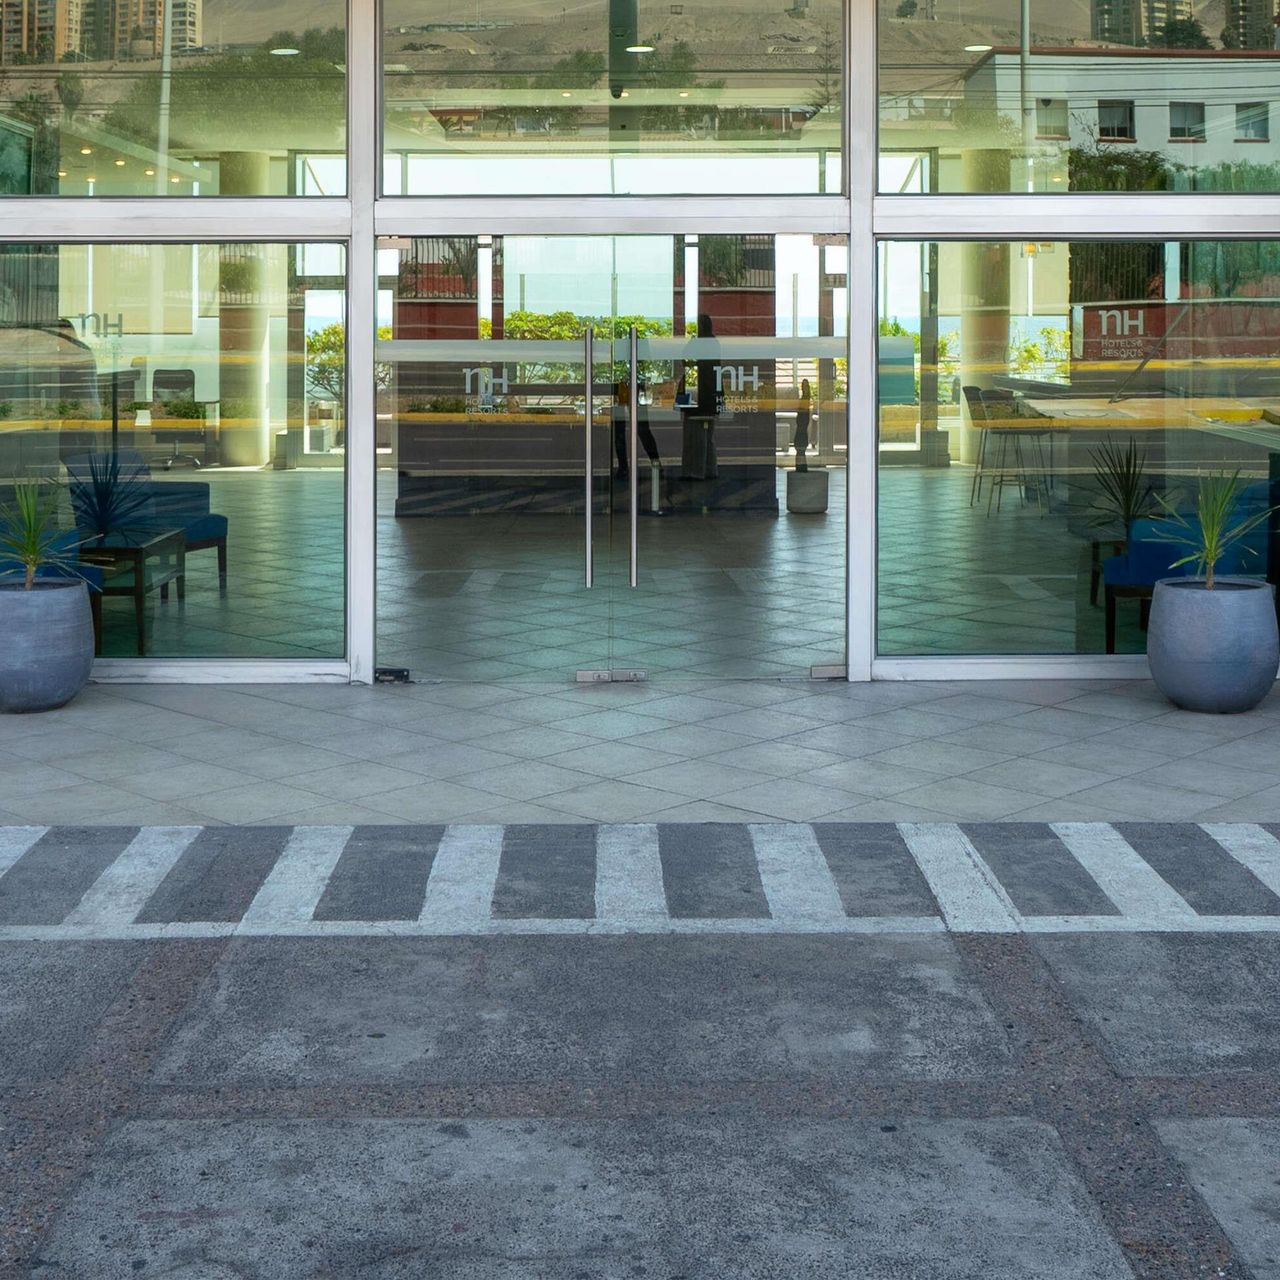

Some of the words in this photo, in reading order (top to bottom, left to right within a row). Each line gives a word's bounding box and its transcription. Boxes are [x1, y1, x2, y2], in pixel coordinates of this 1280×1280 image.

[1101, 349, 1144, 358] RESORTS
[465, 407, 509, 416] RESORTS
[716, 405, 759, 414] RESORTS
